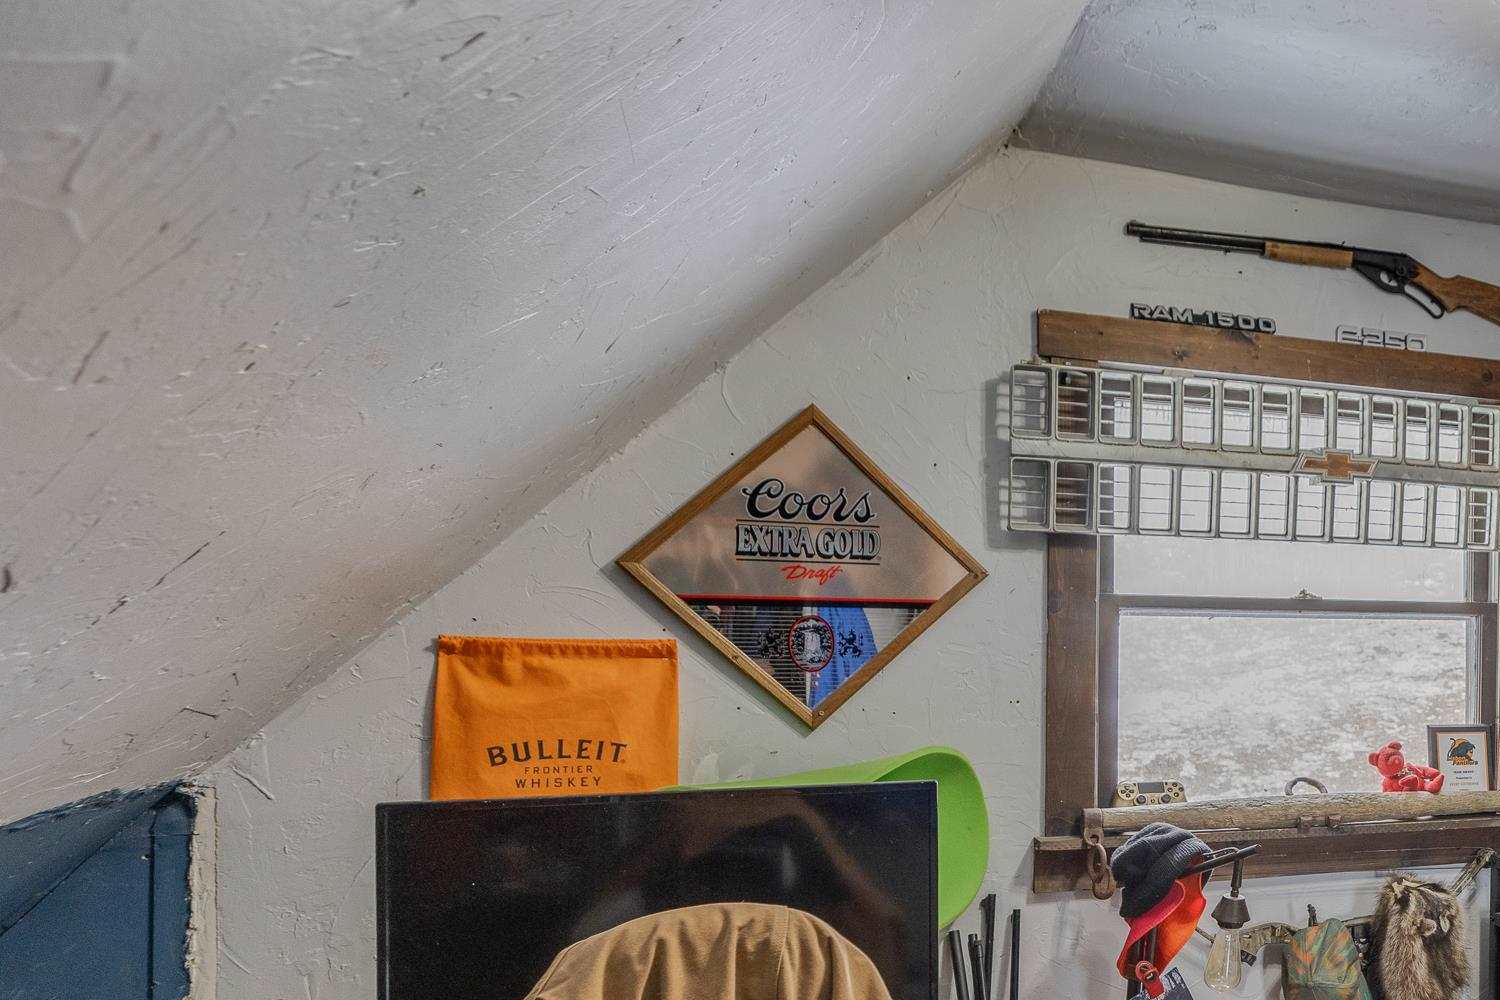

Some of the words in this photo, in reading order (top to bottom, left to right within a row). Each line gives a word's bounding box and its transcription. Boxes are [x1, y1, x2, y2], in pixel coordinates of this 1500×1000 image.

[1130, 302, 1195, 325] RAM
[1203, 310, 1278, 334] 1500
[742, 478, 877, 523] Coors
[736, 524, 816, 557] EXTRA
[816, 527, 882, 561] GOLD
[781, 565, 843, 586] Draft
[486, 739, 626, 767] BULLEIT
[515, 776, 602, 789] WHISKEY
[524, 764, 594, 775] FRONTIER
